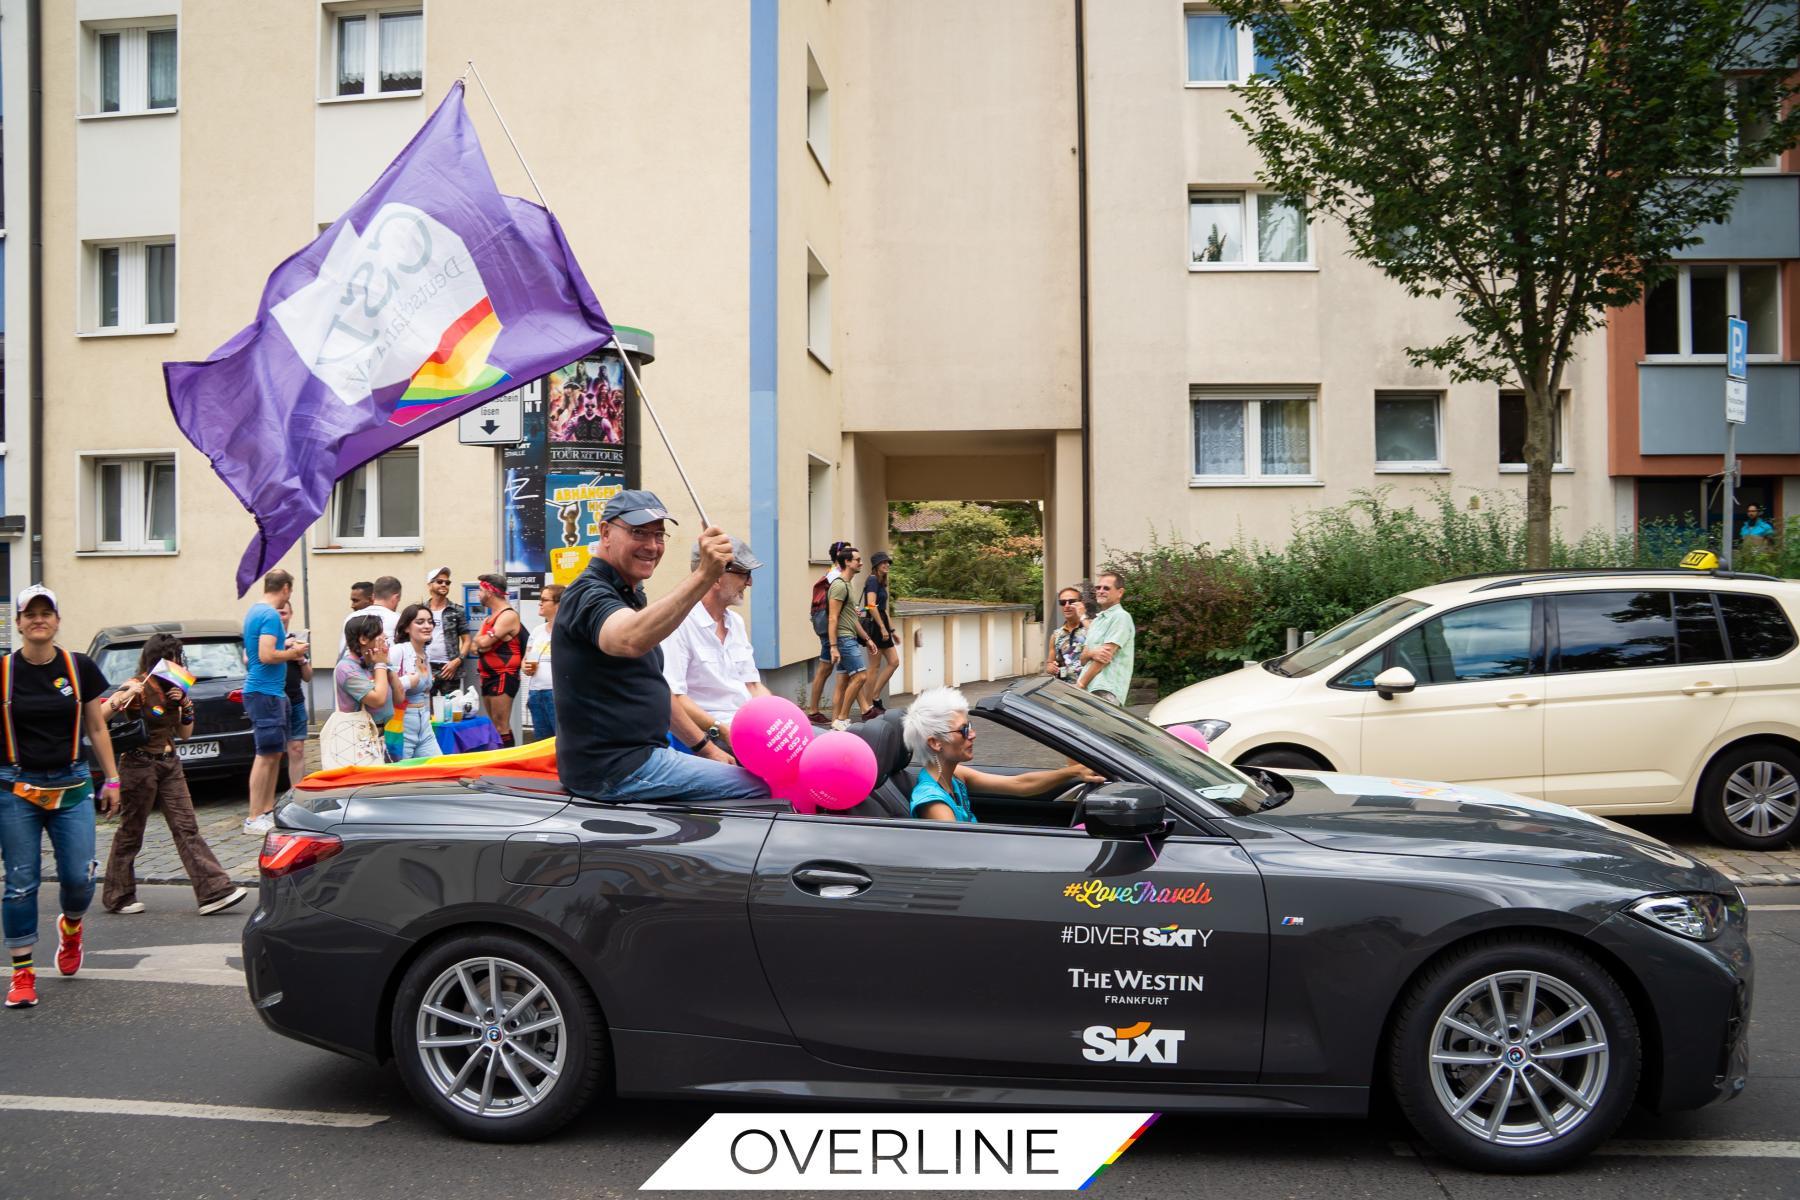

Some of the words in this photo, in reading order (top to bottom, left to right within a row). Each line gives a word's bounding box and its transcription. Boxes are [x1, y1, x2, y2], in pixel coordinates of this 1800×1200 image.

[550, 450, 580, 460] TOUR
[595, 451, 624, 461] TOURS
[189, 742, 217, 755] 2874
[1062, 879, 1213, 909] #LoveTravels
[1104, 995, 1169, 1006] FRANKFURT
